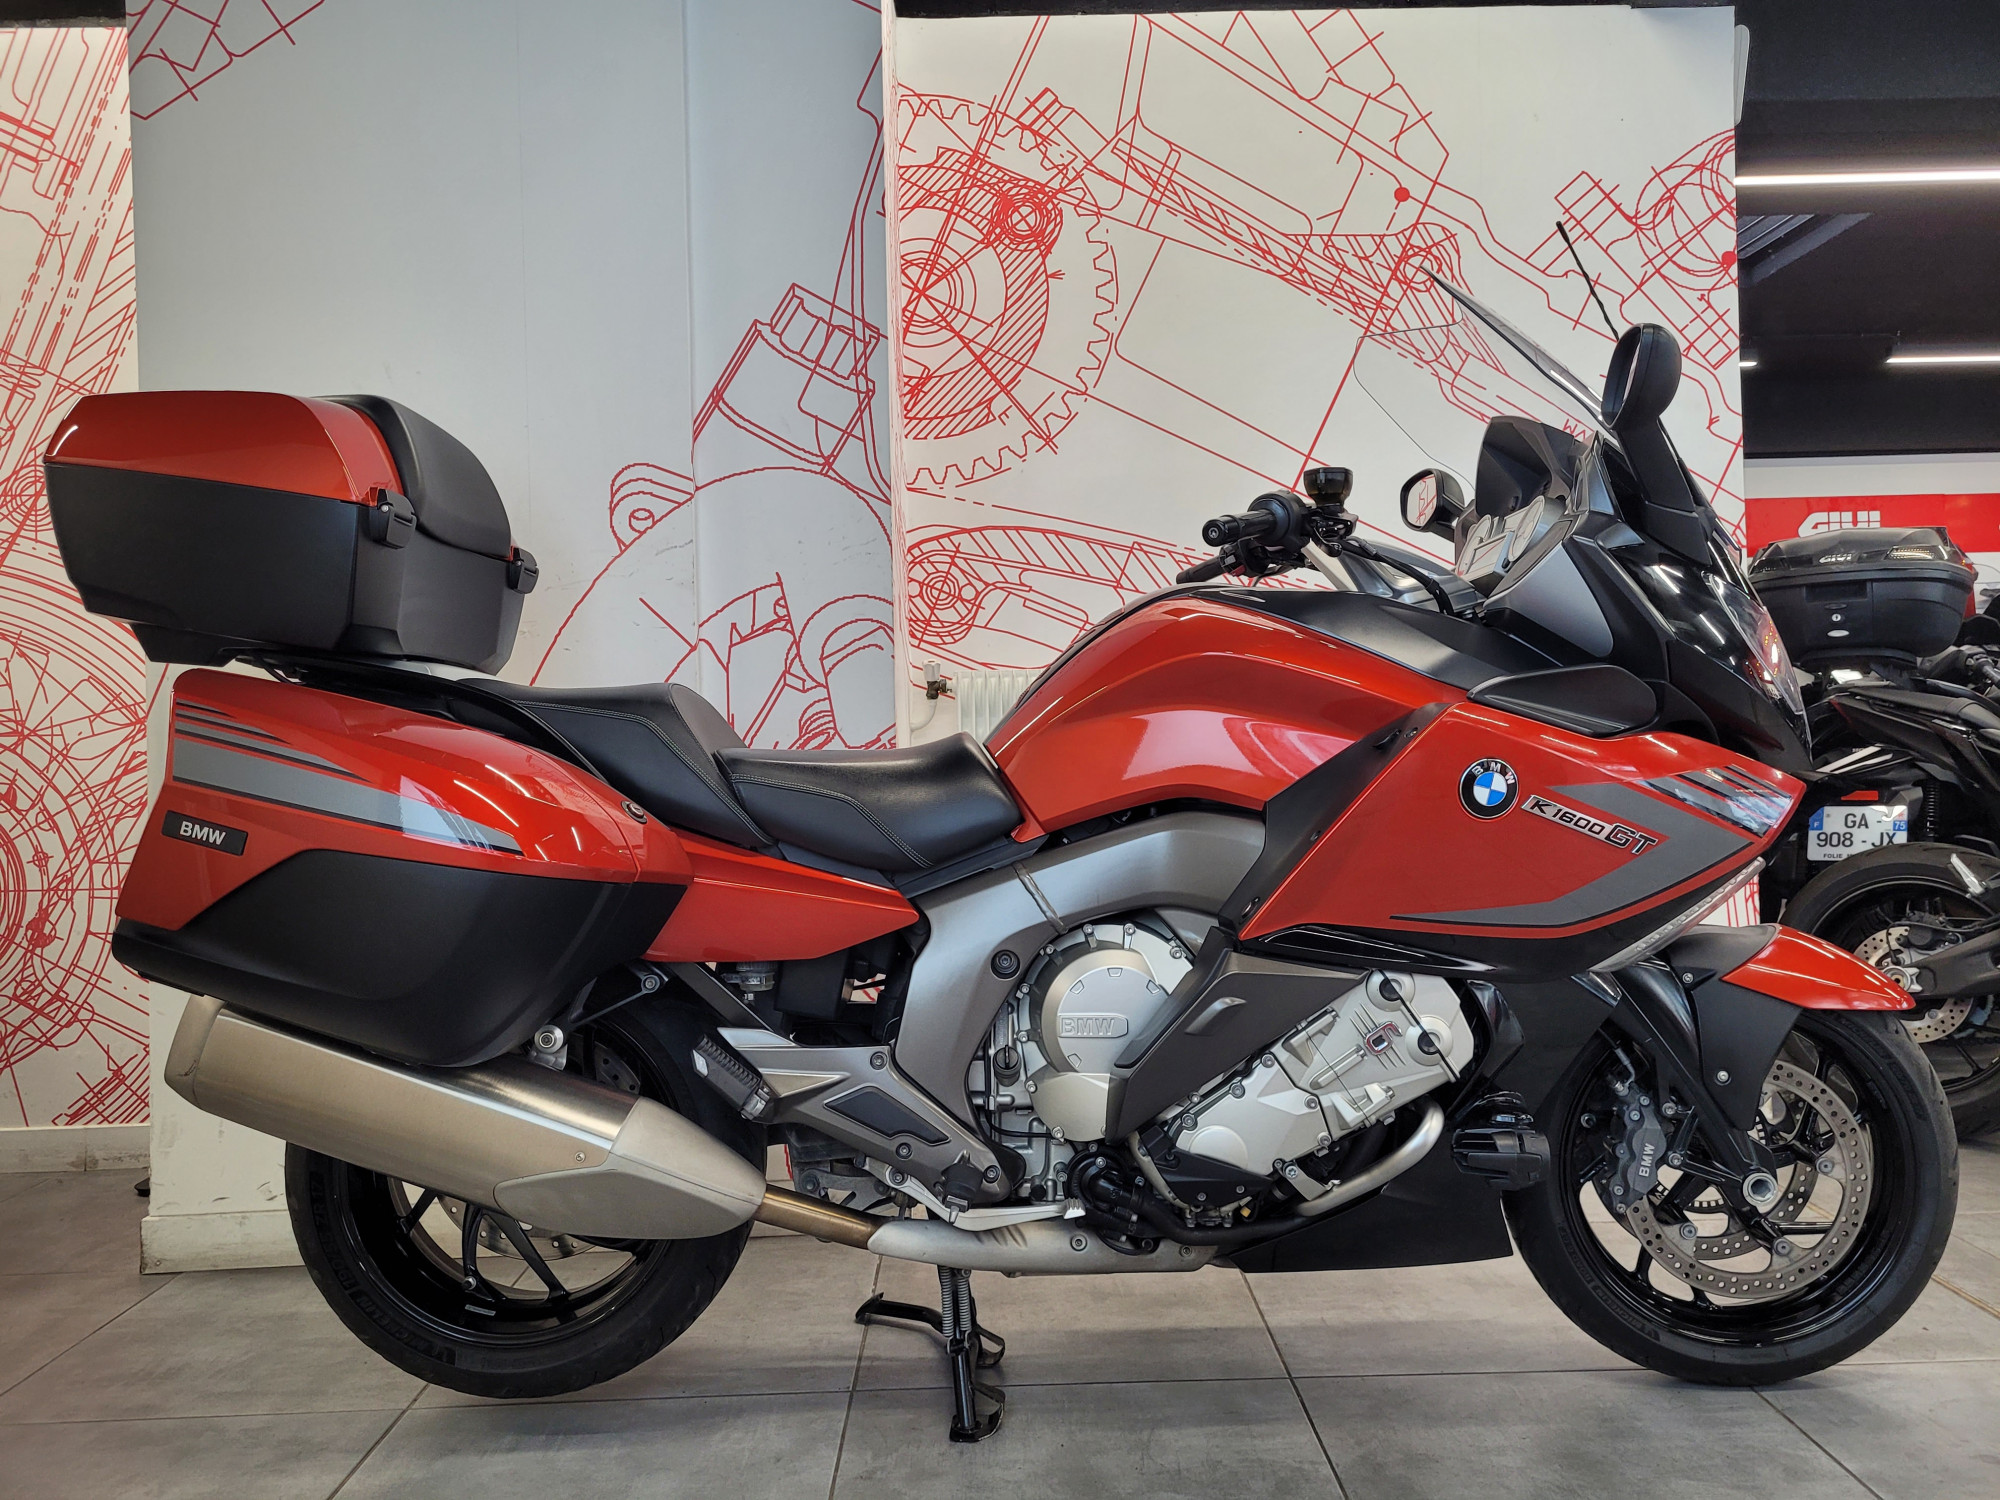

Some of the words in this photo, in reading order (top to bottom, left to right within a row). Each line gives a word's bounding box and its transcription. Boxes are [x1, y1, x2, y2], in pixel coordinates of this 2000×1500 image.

[1798, 510, 1880, 538] GIVI
[1819, 553, 1852, 563] GIVI
[1471, 761, 1516, 784] BMW
[1844, 813, 1869, 829] GA
[1894, 821, 1906, 830] 75
[180, 821, 226, 845] BMW
[1816, 831, 1854, 848] 908
[1871, 832, 1897, 848] JX
[1061, 1018, 1114, 1036] BMW
[1639, 1143, 1655, 1177] BMW
